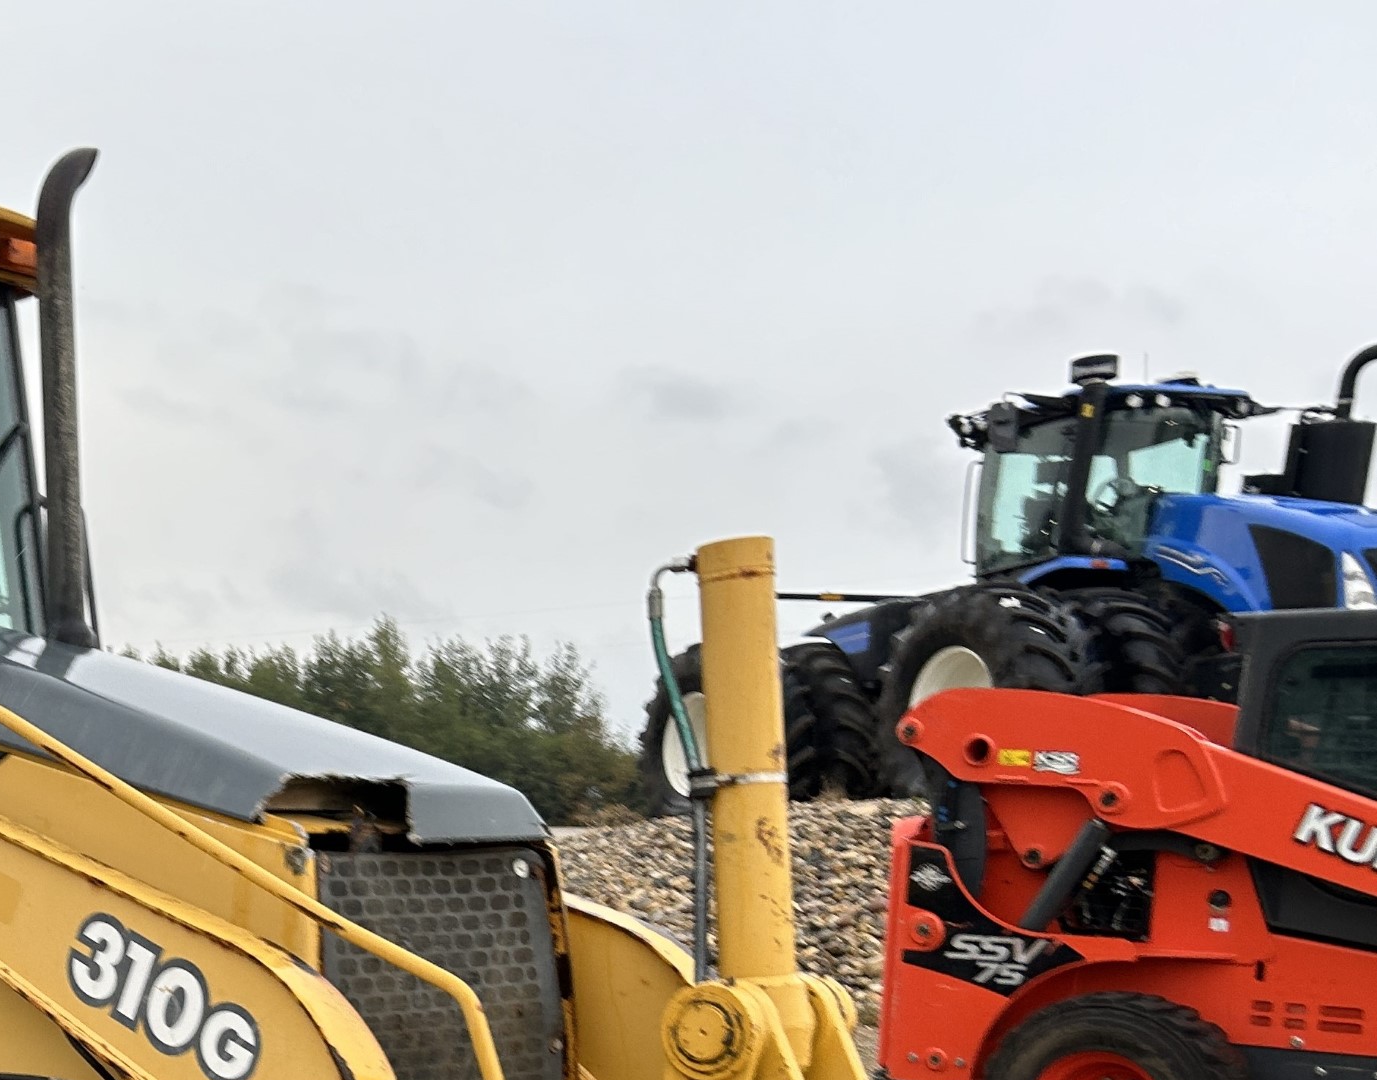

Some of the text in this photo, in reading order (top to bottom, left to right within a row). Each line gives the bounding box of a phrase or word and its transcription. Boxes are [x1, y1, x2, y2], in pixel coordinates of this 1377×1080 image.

[1293, 803, 1377, 868] KU
[944, 933, 1049, 964] SSV
[972, 960, 1028, 986] 75
